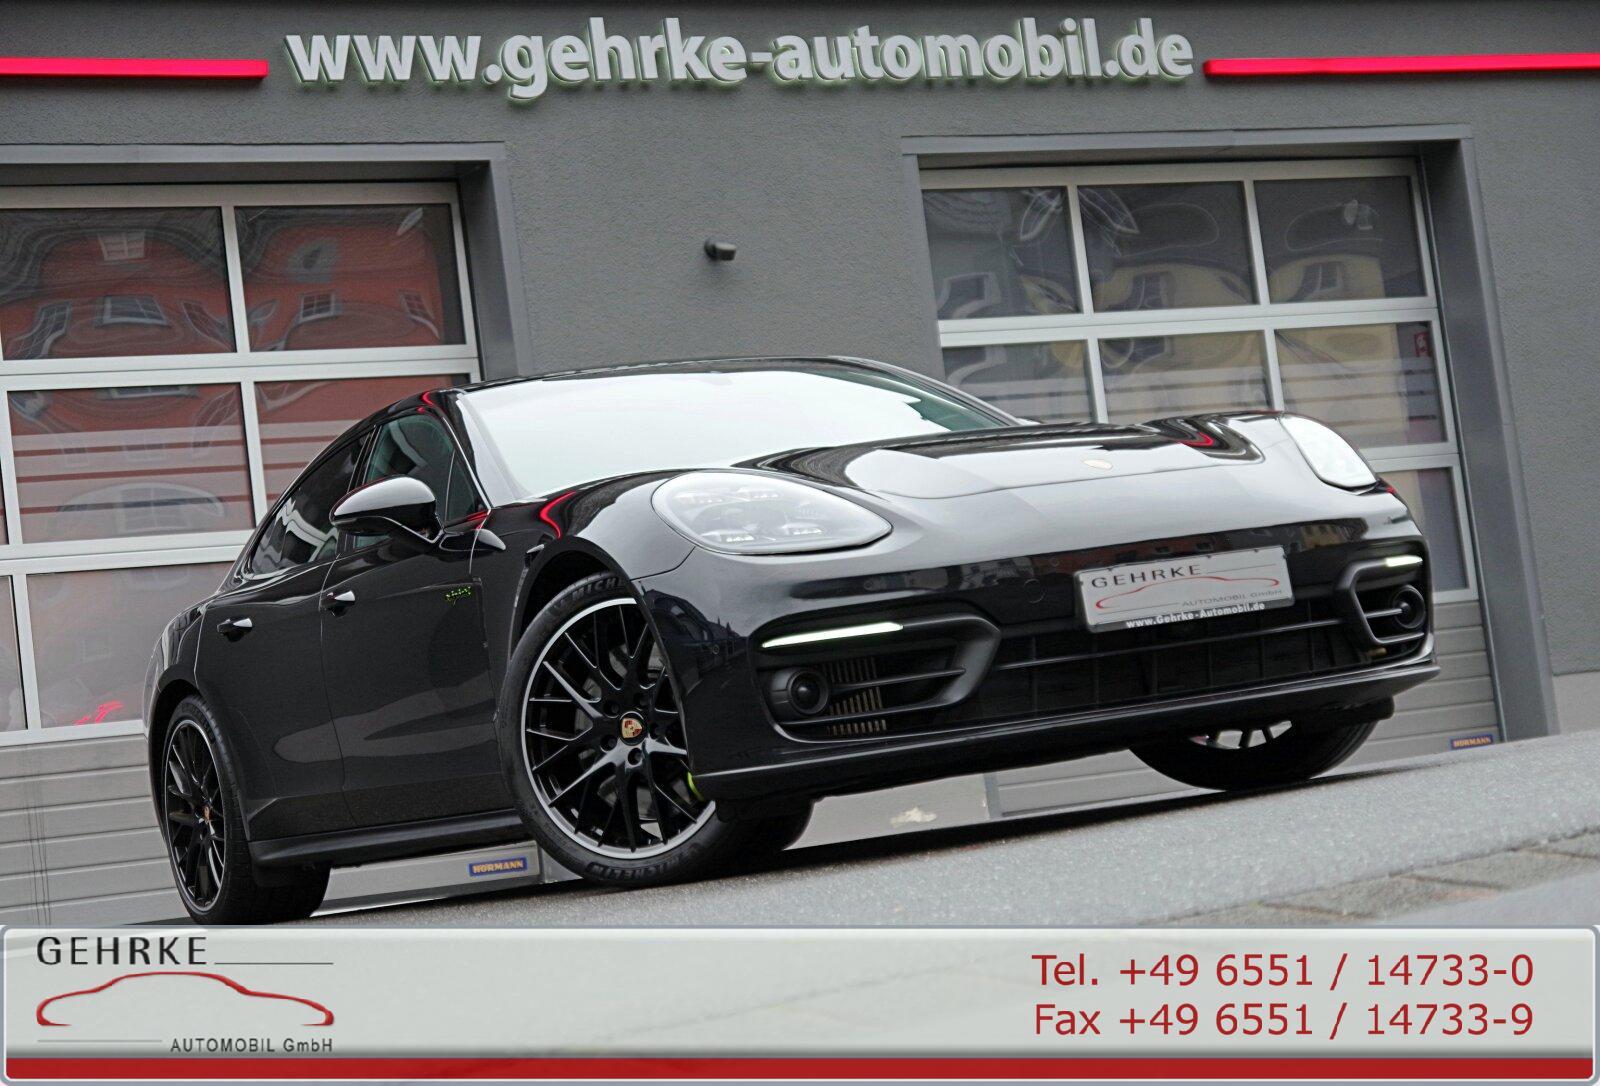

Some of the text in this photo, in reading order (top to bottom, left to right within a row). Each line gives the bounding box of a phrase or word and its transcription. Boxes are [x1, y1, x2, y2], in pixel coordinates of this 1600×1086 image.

[285, 17, 1194, 99] www.gehrke-automobil.de
[1091, 564, 1201, 588] GEHRKE
[1182, 594, 1246, 608] AUTOMOBIL
[1126, 602, 1266, 629] www.Gehrke-Automobil.de
